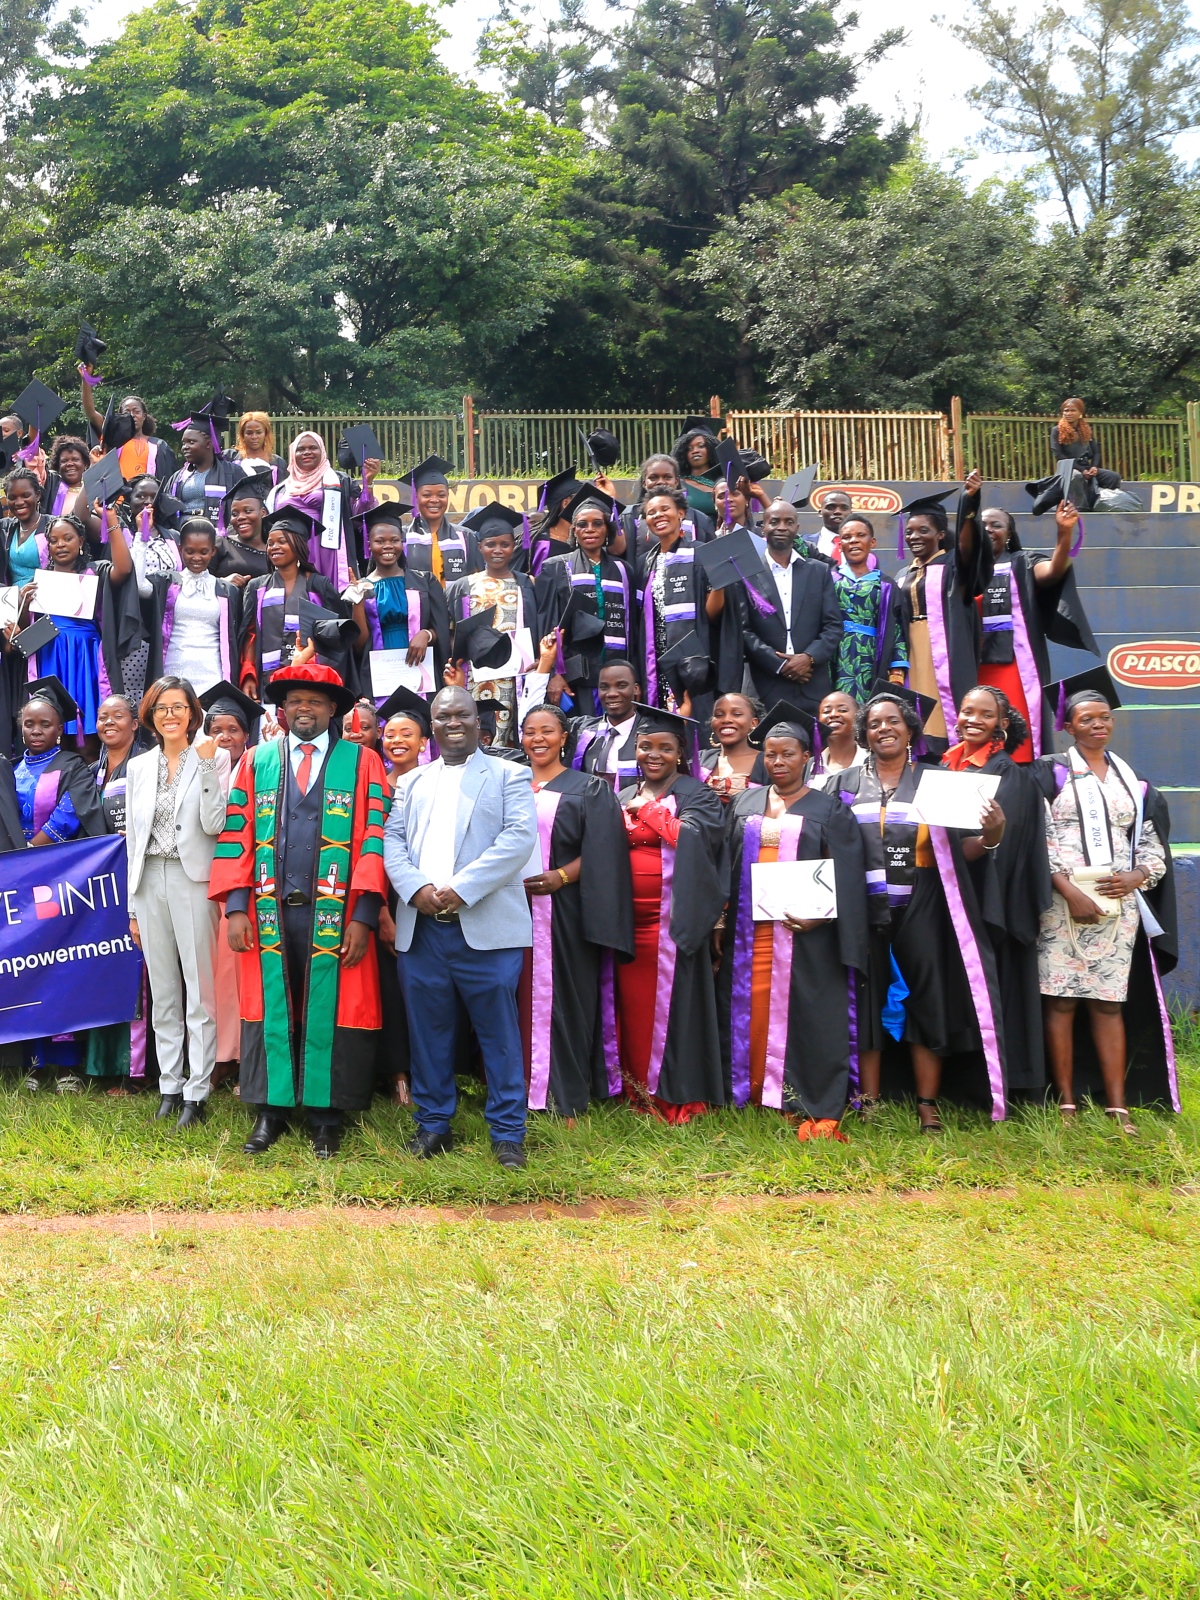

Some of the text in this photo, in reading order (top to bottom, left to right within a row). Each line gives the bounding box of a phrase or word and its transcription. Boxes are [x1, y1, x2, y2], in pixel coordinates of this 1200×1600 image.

[1123, 654, 1200, 674] PLASCO
[1089, 810, 1098, 820] OF
[1092, 827, 1102, 847] 2024
[32, 872, 120, 920] BINTI
